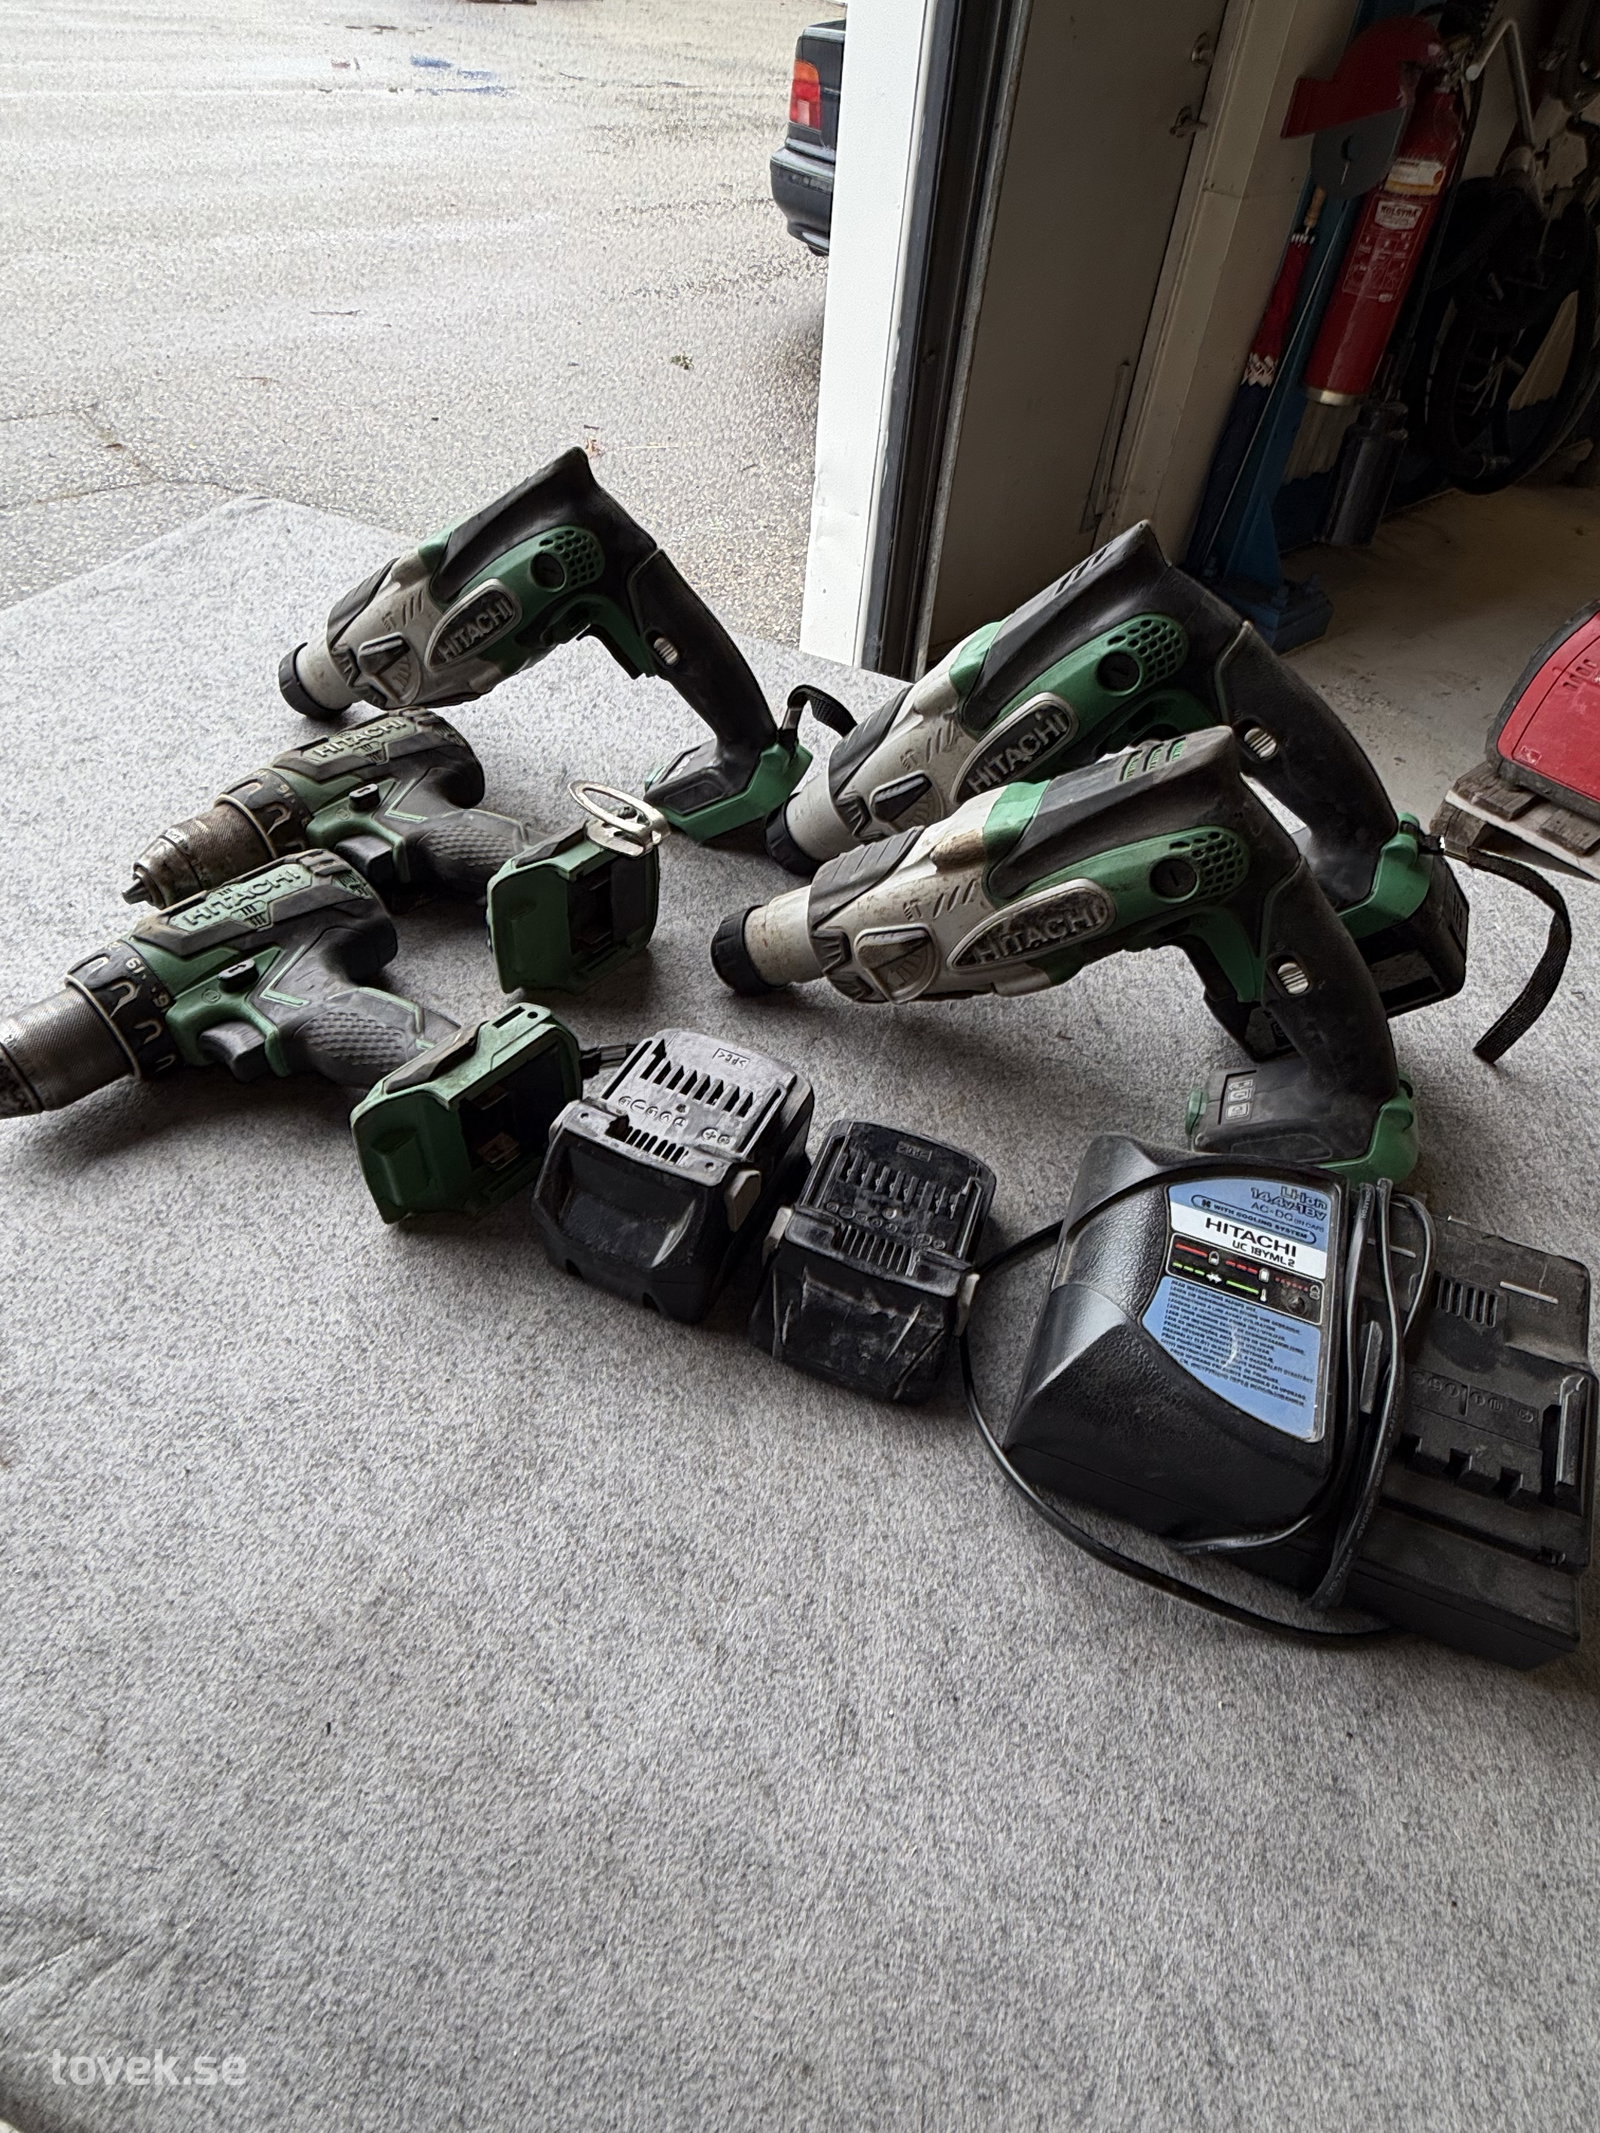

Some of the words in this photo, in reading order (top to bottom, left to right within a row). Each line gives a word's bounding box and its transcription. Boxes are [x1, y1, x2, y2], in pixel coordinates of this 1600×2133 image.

[437, 600, 514, 661] HITACHI
[313, 719, 407, 757] HITACHI
[966, 711, 1068, 793] HITACHI
[182, 869, 302, 926] HITACHI
[973, 905, 1101, 964] HITACHI
[1205, 1217, 1297, 1258] HITACHI
[1213, 1203, 1235, 1215] WITH
[1236, 1210, 1273, 1229] COOLING
[1275, 1221, 1308, 1240] SYSTEM
[1232, 1240, 1246, 1251] UC
